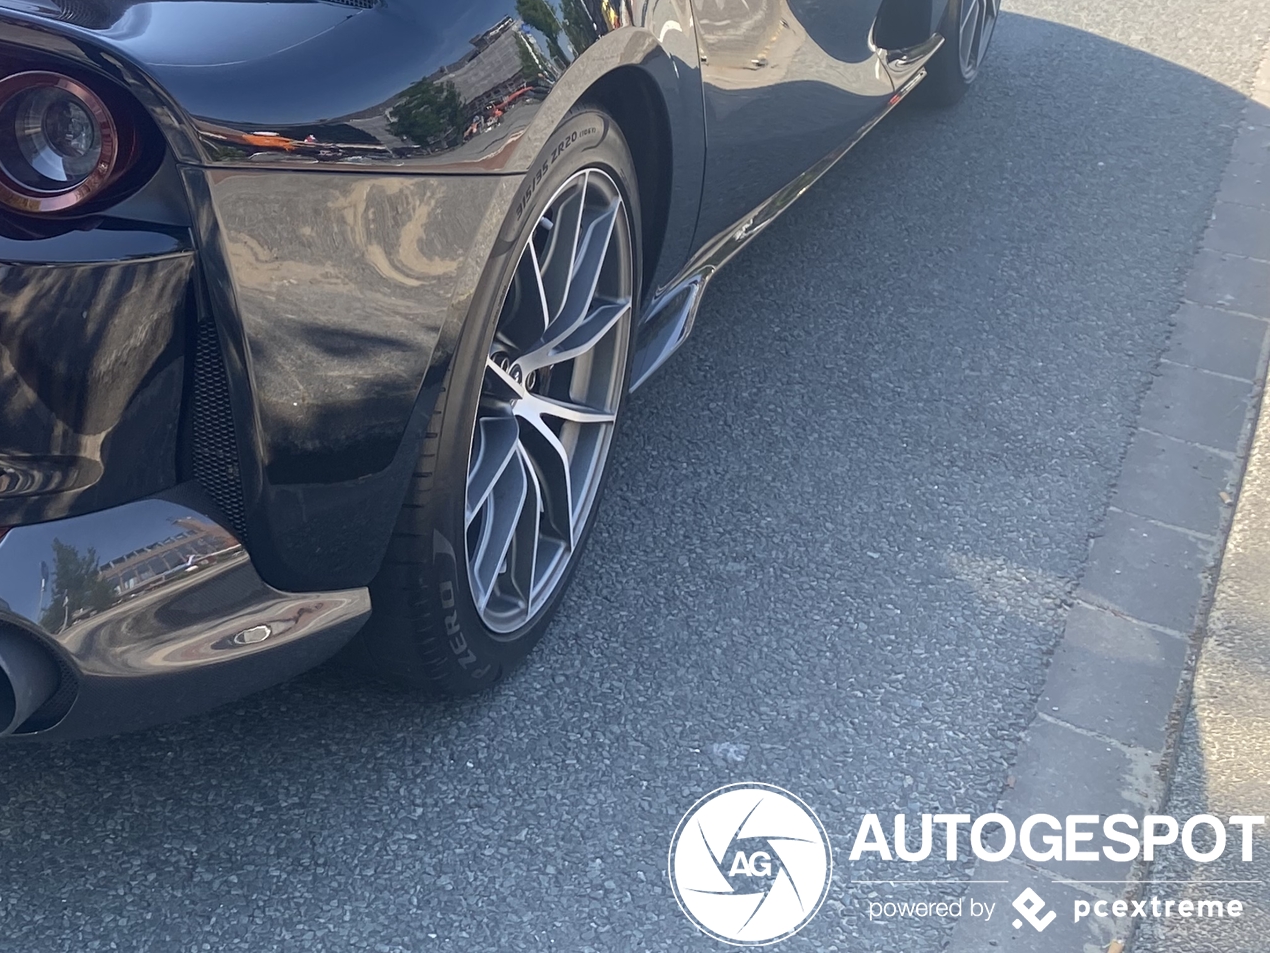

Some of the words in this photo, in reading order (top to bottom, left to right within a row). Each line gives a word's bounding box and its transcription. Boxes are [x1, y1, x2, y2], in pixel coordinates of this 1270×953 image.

[515, 160, 548, 220] 315/35
[551, 131, 577, 164] ZR20
[439, 580, 477, 669] ZERO
